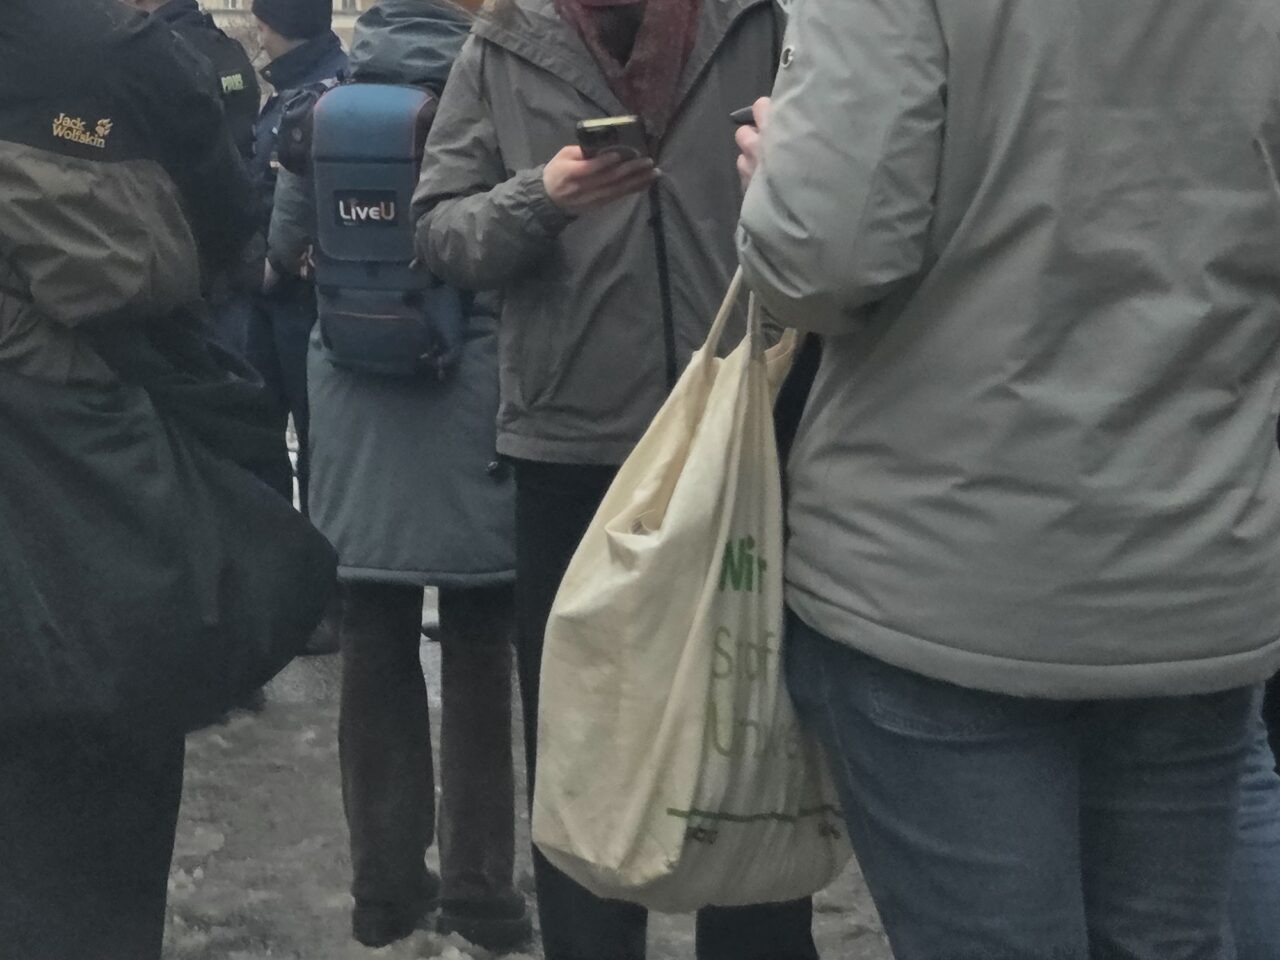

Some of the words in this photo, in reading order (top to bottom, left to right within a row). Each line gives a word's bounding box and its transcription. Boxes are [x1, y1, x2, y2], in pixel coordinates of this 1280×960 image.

[53, 112, 87, 131] Jack
[52, 123, 106, 149] Wolfskin
[338, 198, 395, 221] LiveU
